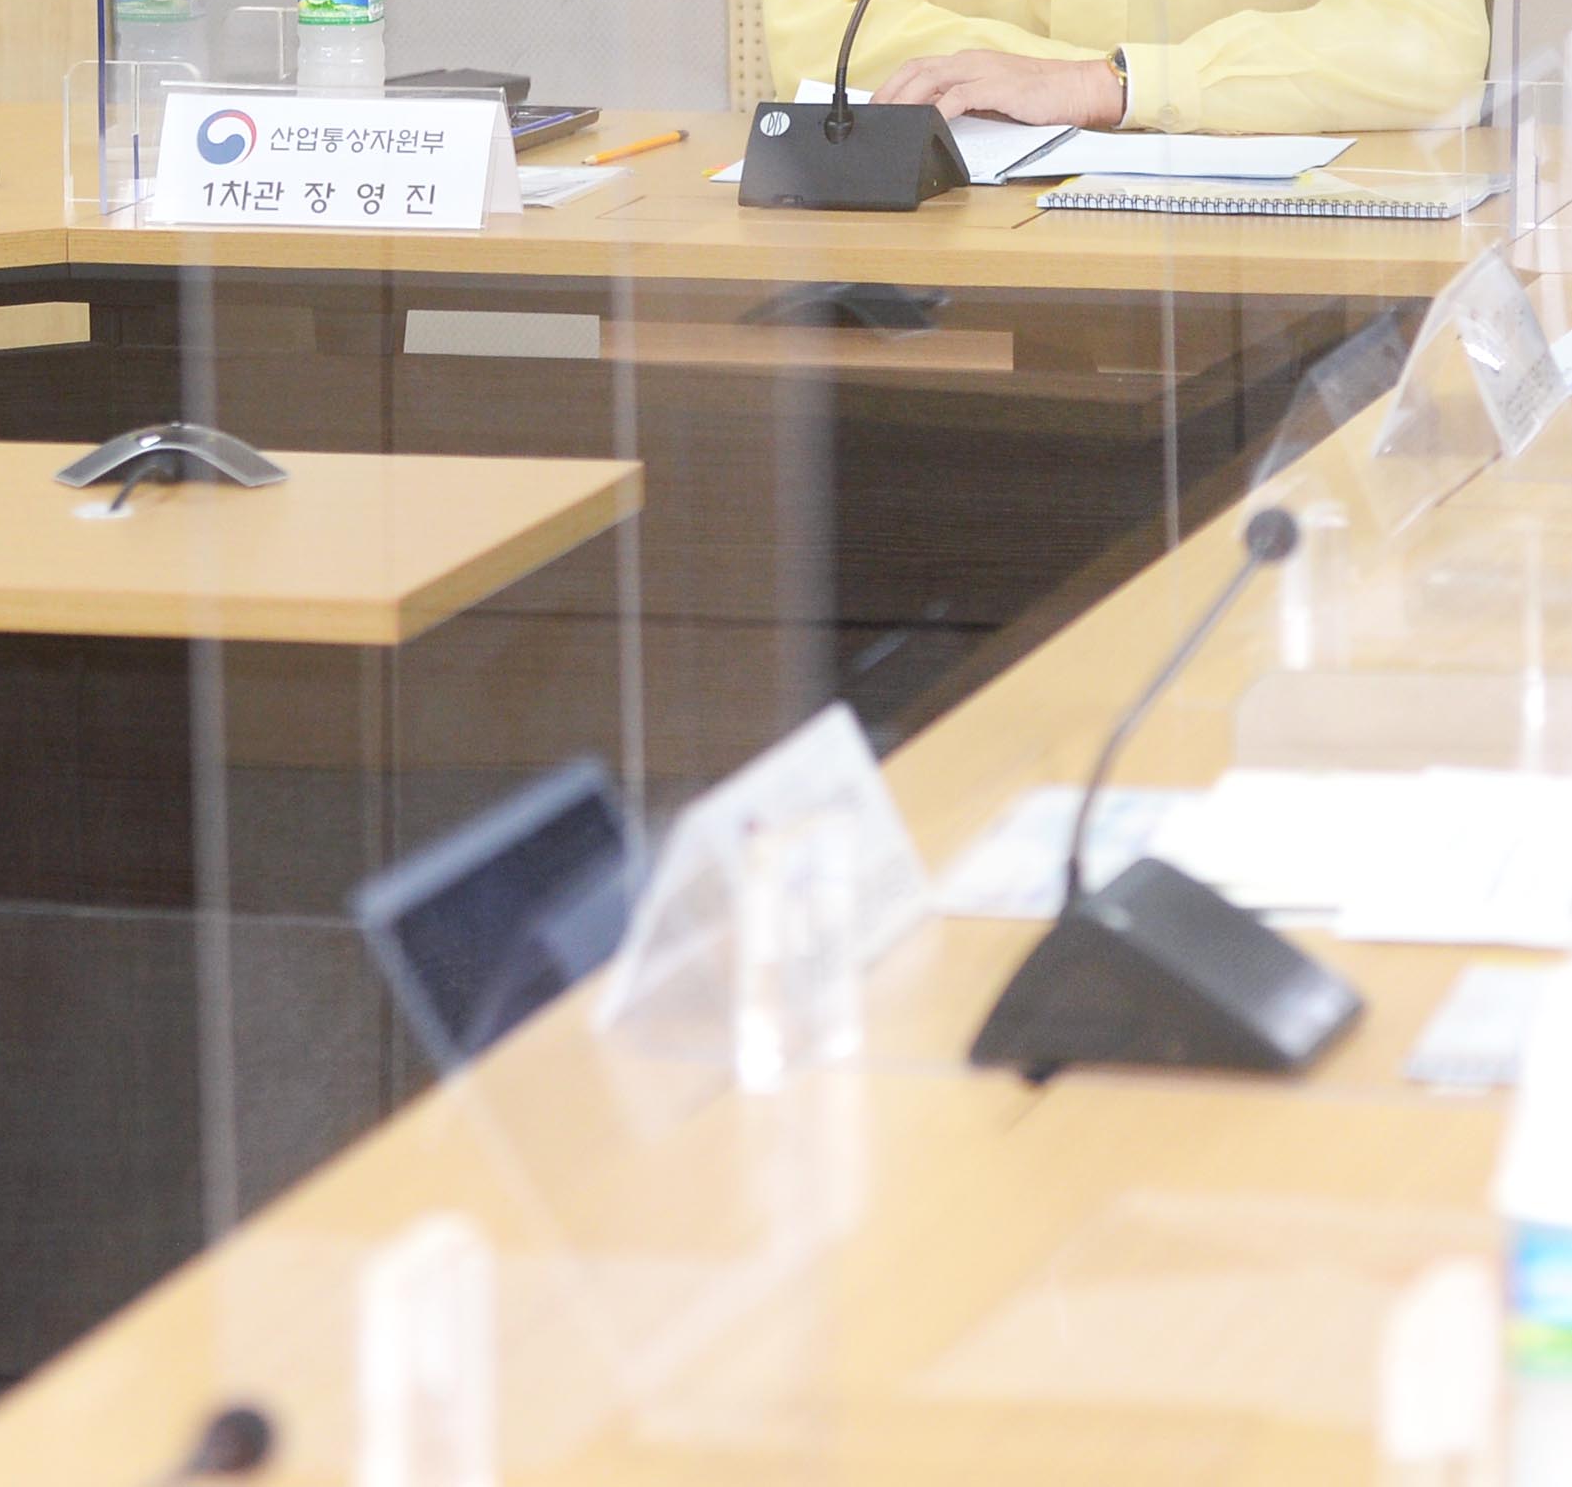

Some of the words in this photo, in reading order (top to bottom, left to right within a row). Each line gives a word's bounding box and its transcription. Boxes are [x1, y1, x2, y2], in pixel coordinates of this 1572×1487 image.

[270, 126, 444, 155] 산업통상자원부
[202, 180, 285, 212] 1차관
[304, 181, 336, 214] 장
[357, 182, 385, 215] 영
[406, 183, 436, 215] 진
